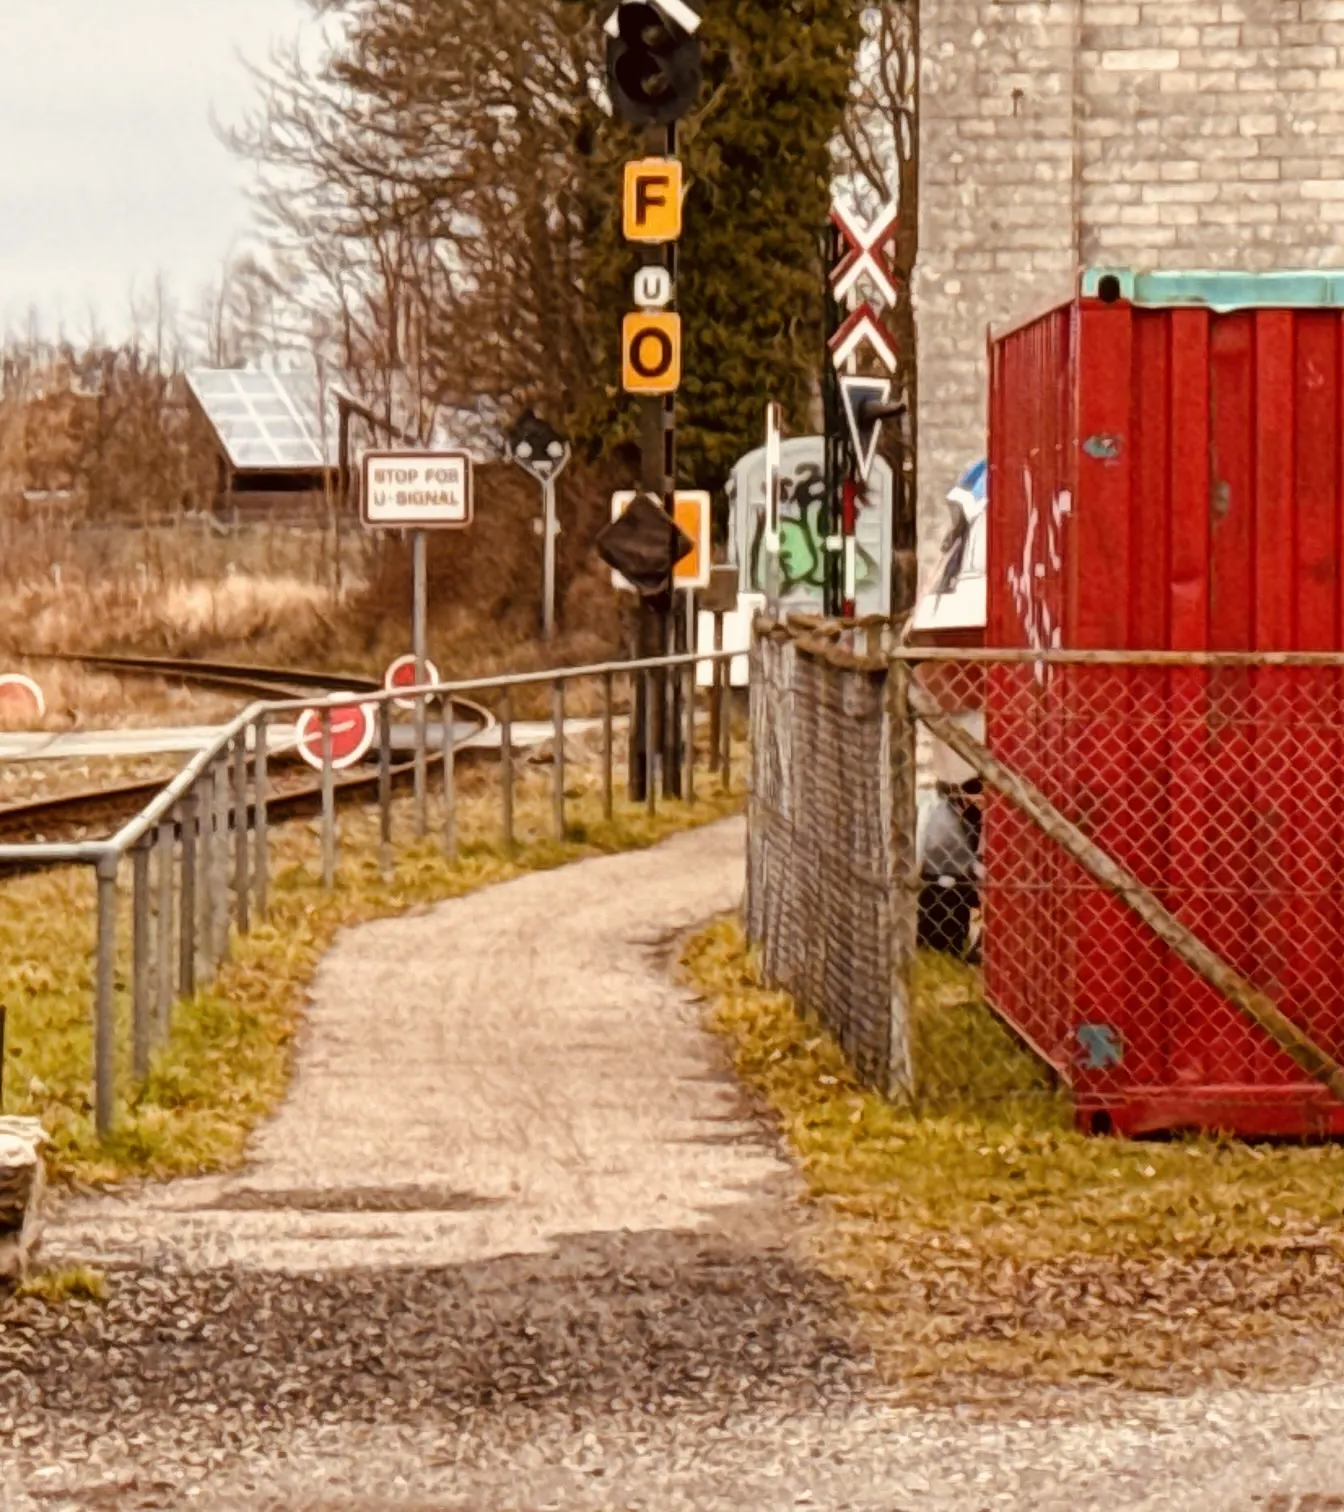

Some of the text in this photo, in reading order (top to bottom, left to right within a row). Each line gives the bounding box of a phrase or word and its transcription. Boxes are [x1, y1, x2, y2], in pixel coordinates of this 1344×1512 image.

[635, 175, 669, 225] F
[642, 276, 661, 300] U
[629, 327, 672, 378] O
[374, 468, 460, 485] STOP FOR
